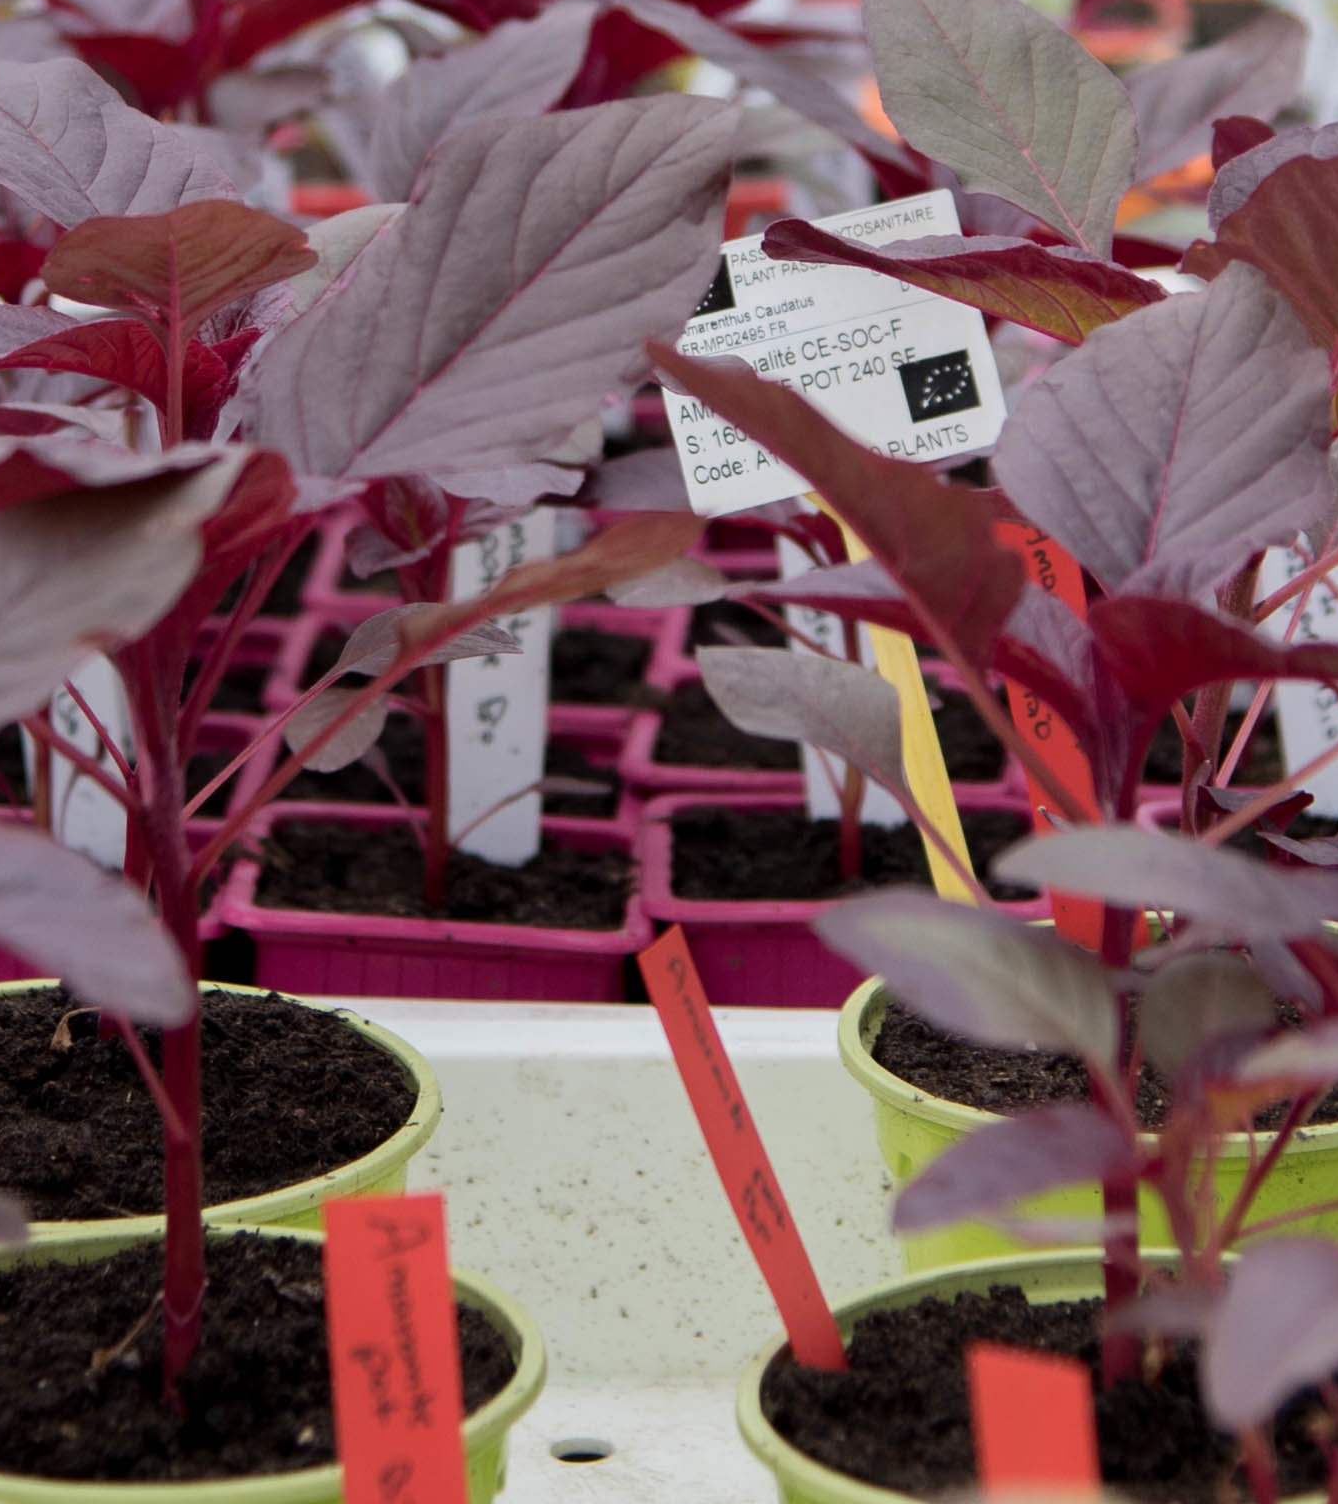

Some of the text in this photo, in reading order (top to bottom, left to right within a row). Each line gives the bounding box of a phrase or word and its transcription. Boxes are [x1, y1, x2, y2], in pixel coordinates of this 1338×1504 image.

[734, 266, 777, 288] PLANT
[686, 295, 815, 338] marenthus Caudatus
[769, 320, 788, 335] FR
[801, 319, 902, 361] CE-SOC-F
[801, 366, 843, 393] POT
[849, 356, 885, 382] 240
[686, 435, 707, 455] S:
[888, 424, 969, 458] PLANTS
[693, 458, 750, 484] Code:
